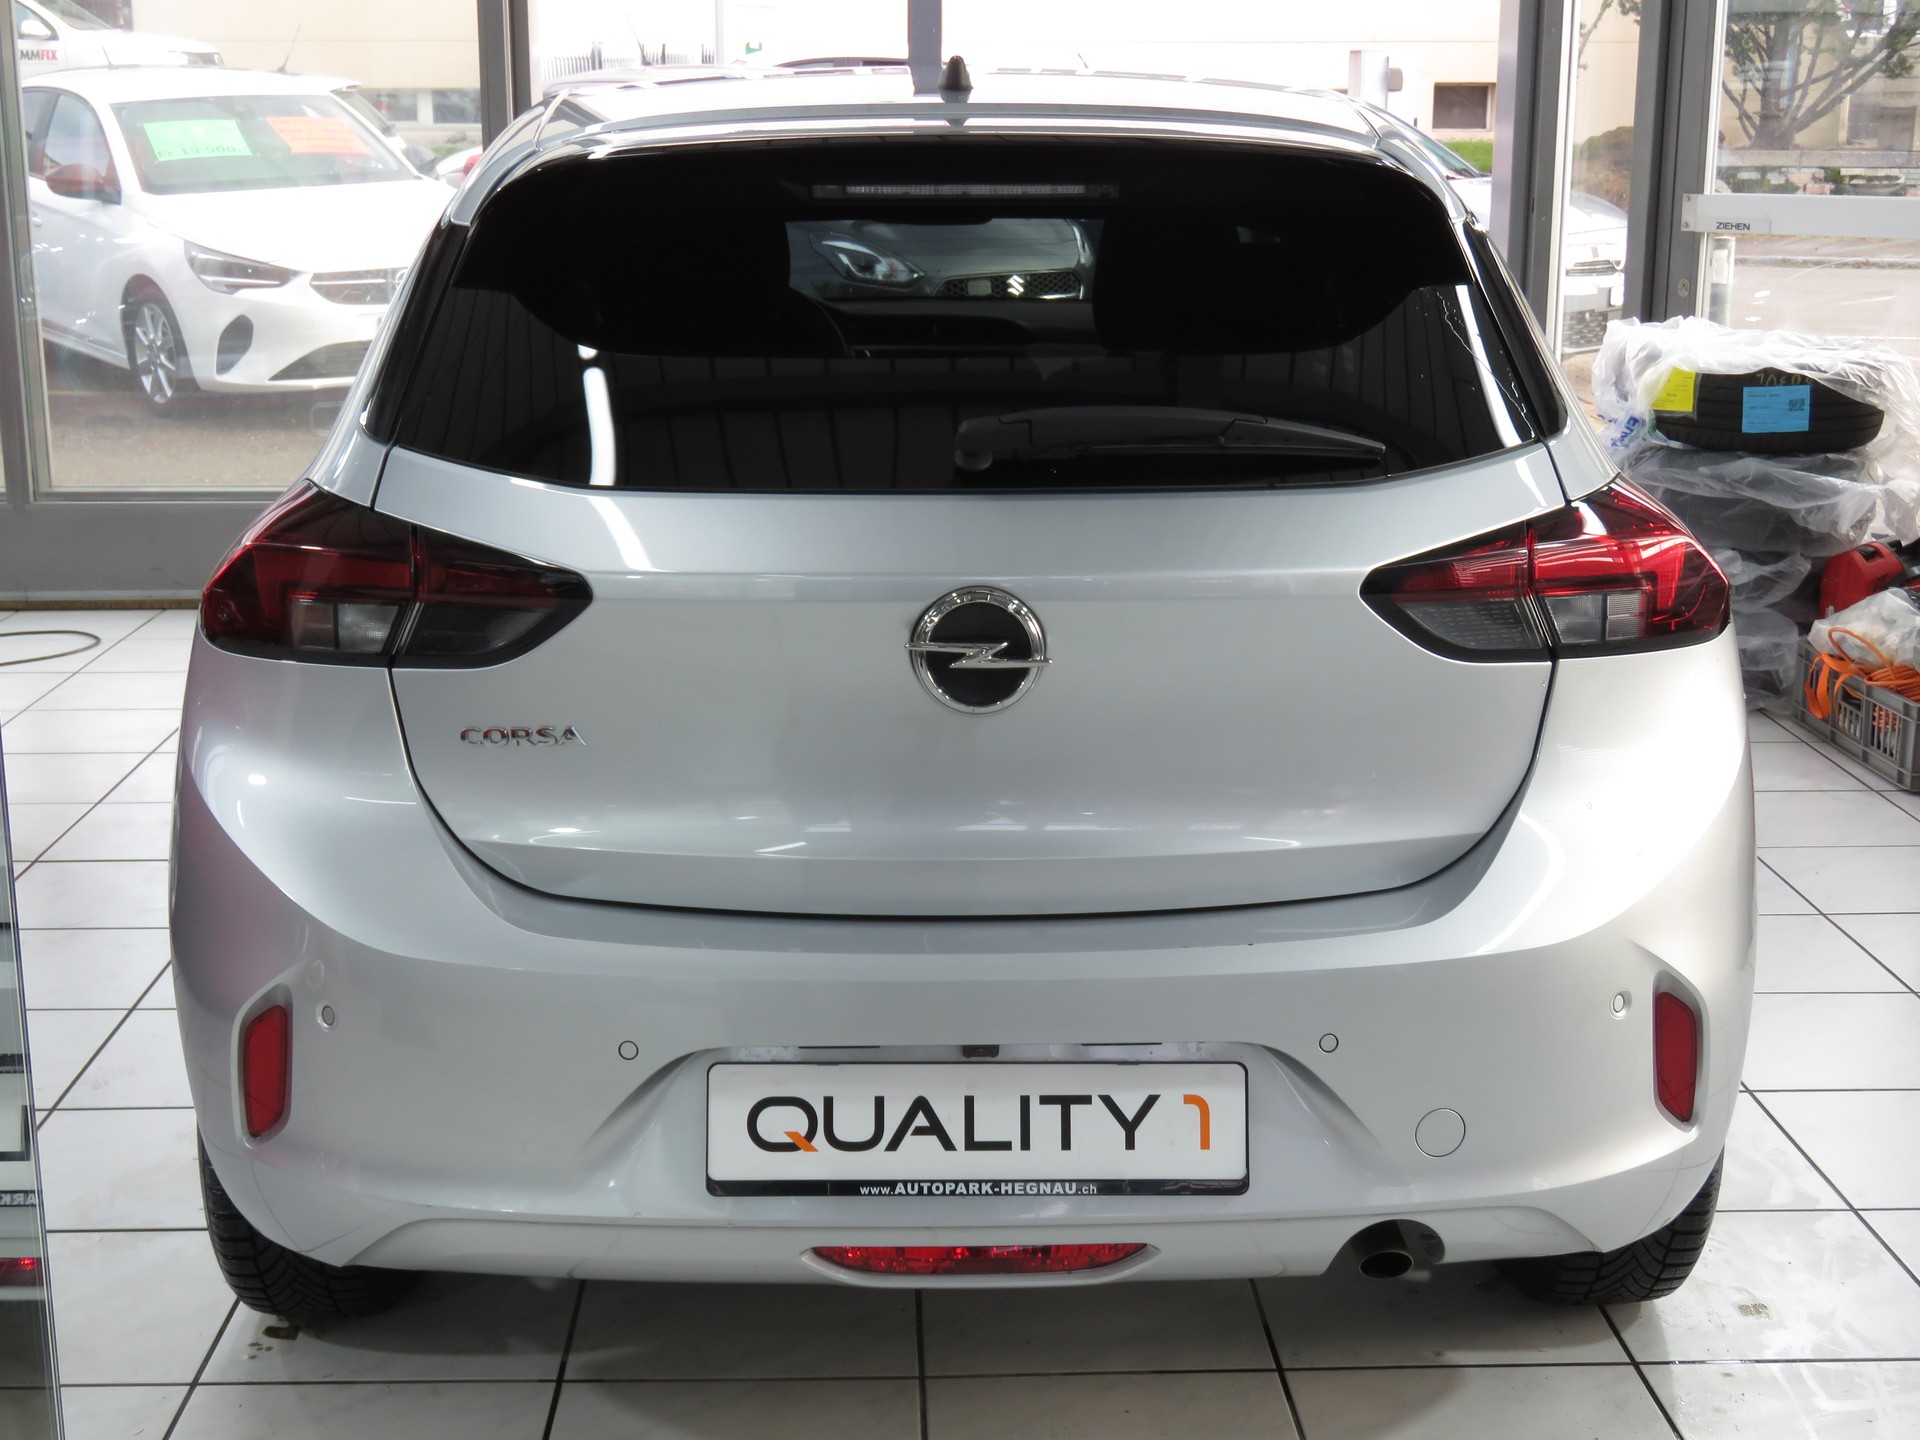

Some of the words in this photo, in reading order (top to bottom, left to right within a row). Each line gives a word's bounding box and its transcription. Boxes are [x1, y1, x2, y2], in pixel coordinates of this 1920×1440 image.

[1715, 221, 1751, 231] ZIEHEN
[460, 726, 586, 746] CORSA
[746, 1094, 1161, 1153] QUALITY
[1182, 1093, 1211, 1151] 1
[859, 1181, 1098, 1196] www.AUTOPARK-HEGNAU.ch
